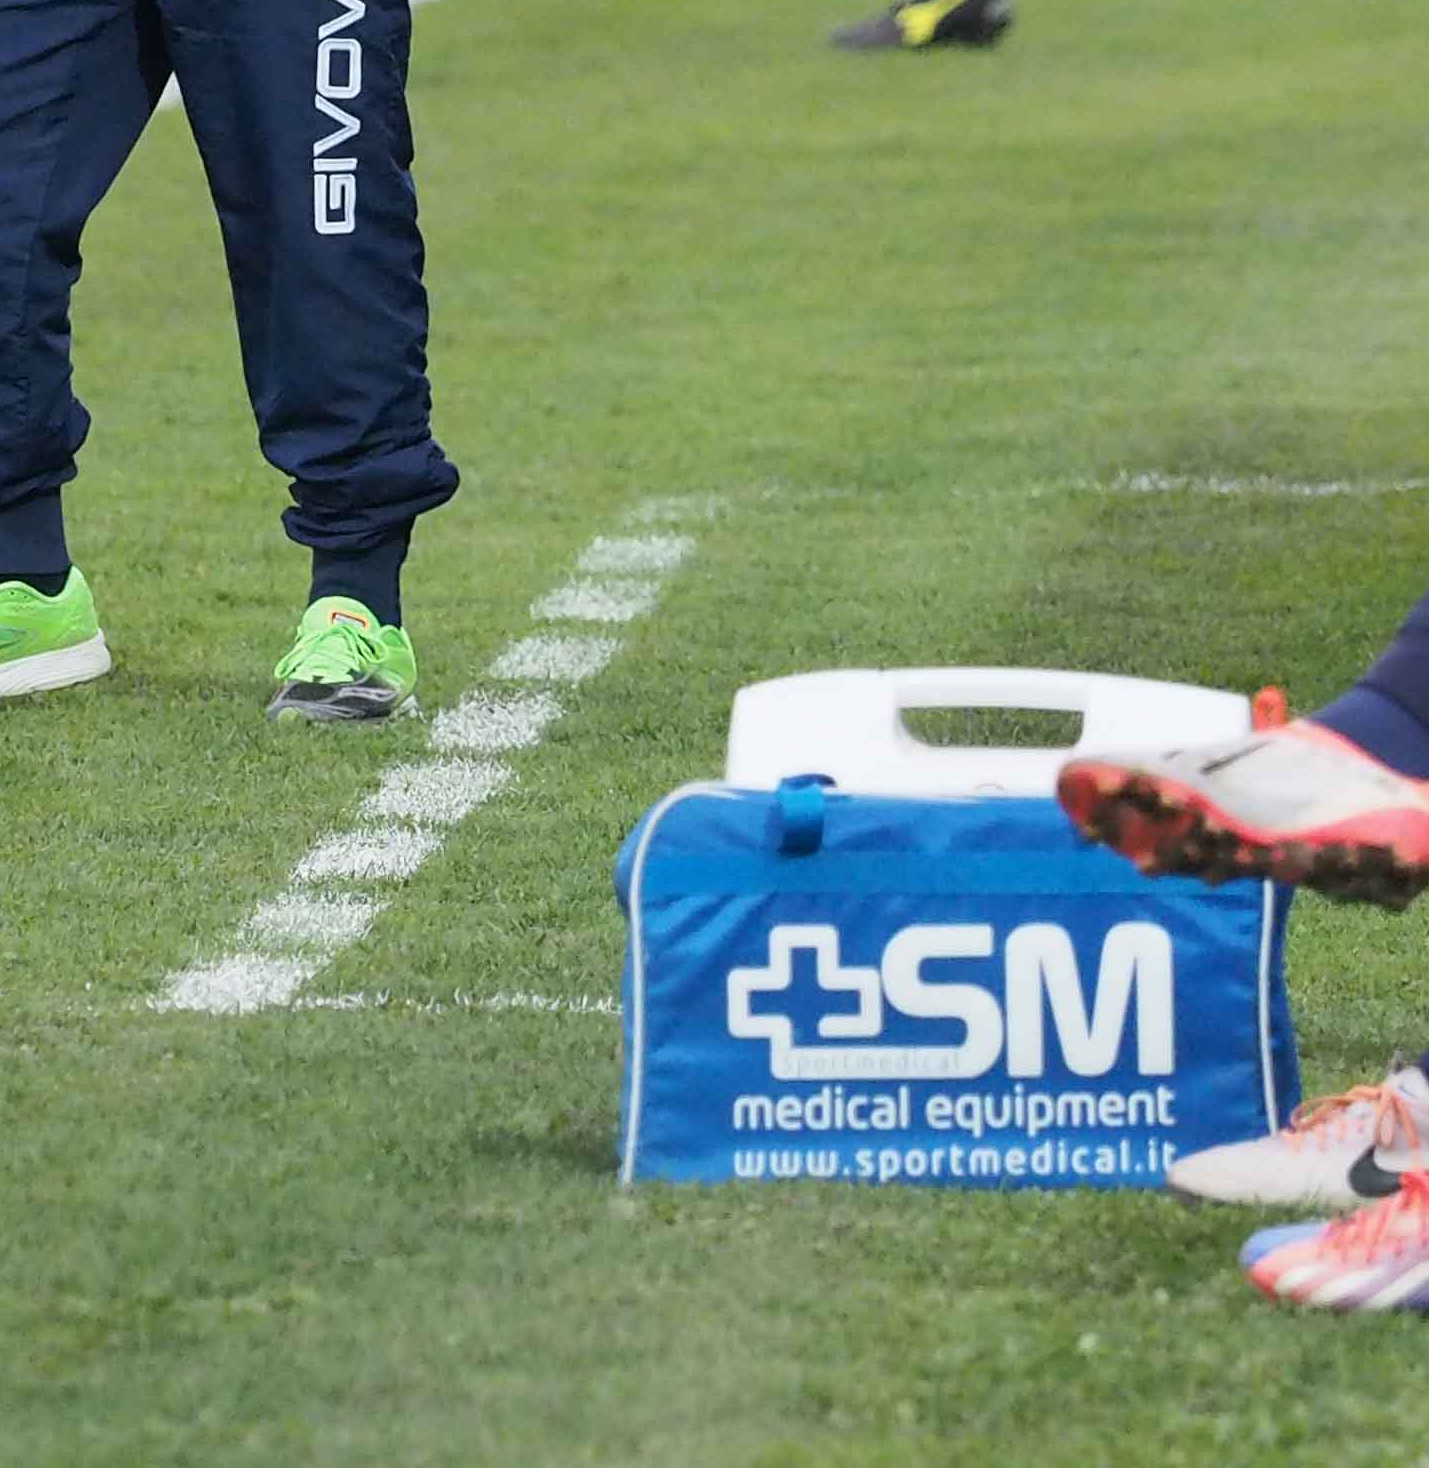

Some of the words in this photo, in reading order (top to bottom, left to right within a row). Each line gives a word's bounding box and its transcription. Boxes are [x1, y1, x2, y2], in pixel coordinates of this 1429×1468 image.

[881, 922, 1174, 1079] SM
[733, 1085, 909, 1130] medical
[926, 1084, 1176, 1138] equipment
[733, 1138, 1177, 1182] www.sportmedical.it
